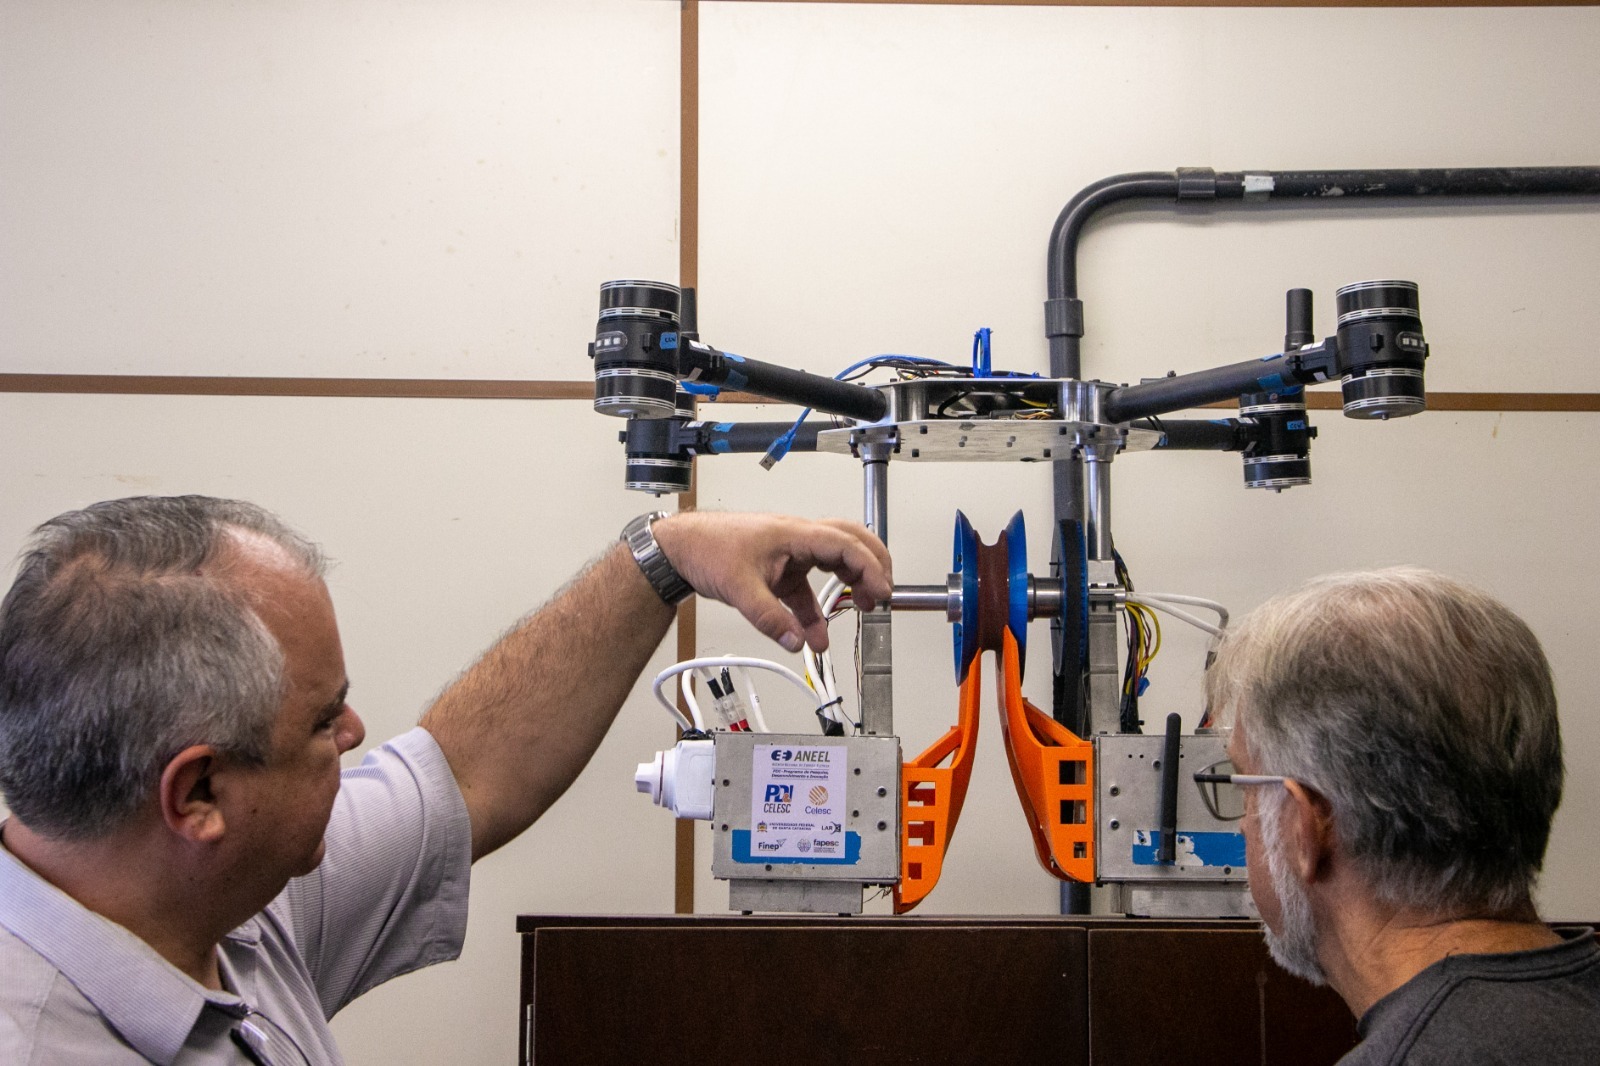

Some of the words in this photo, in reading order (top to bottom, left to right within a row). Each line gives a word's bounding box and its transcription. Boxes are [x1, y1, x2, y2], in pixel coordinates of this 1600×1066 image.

[794, 750, 831, 762] ANEEL
[763, 803, 792, 814] CELESC
[804, 806, 832, 815] Celesc
[758, 842, 780, 851] Finep
[813, 839, 840, 847] fapesc
